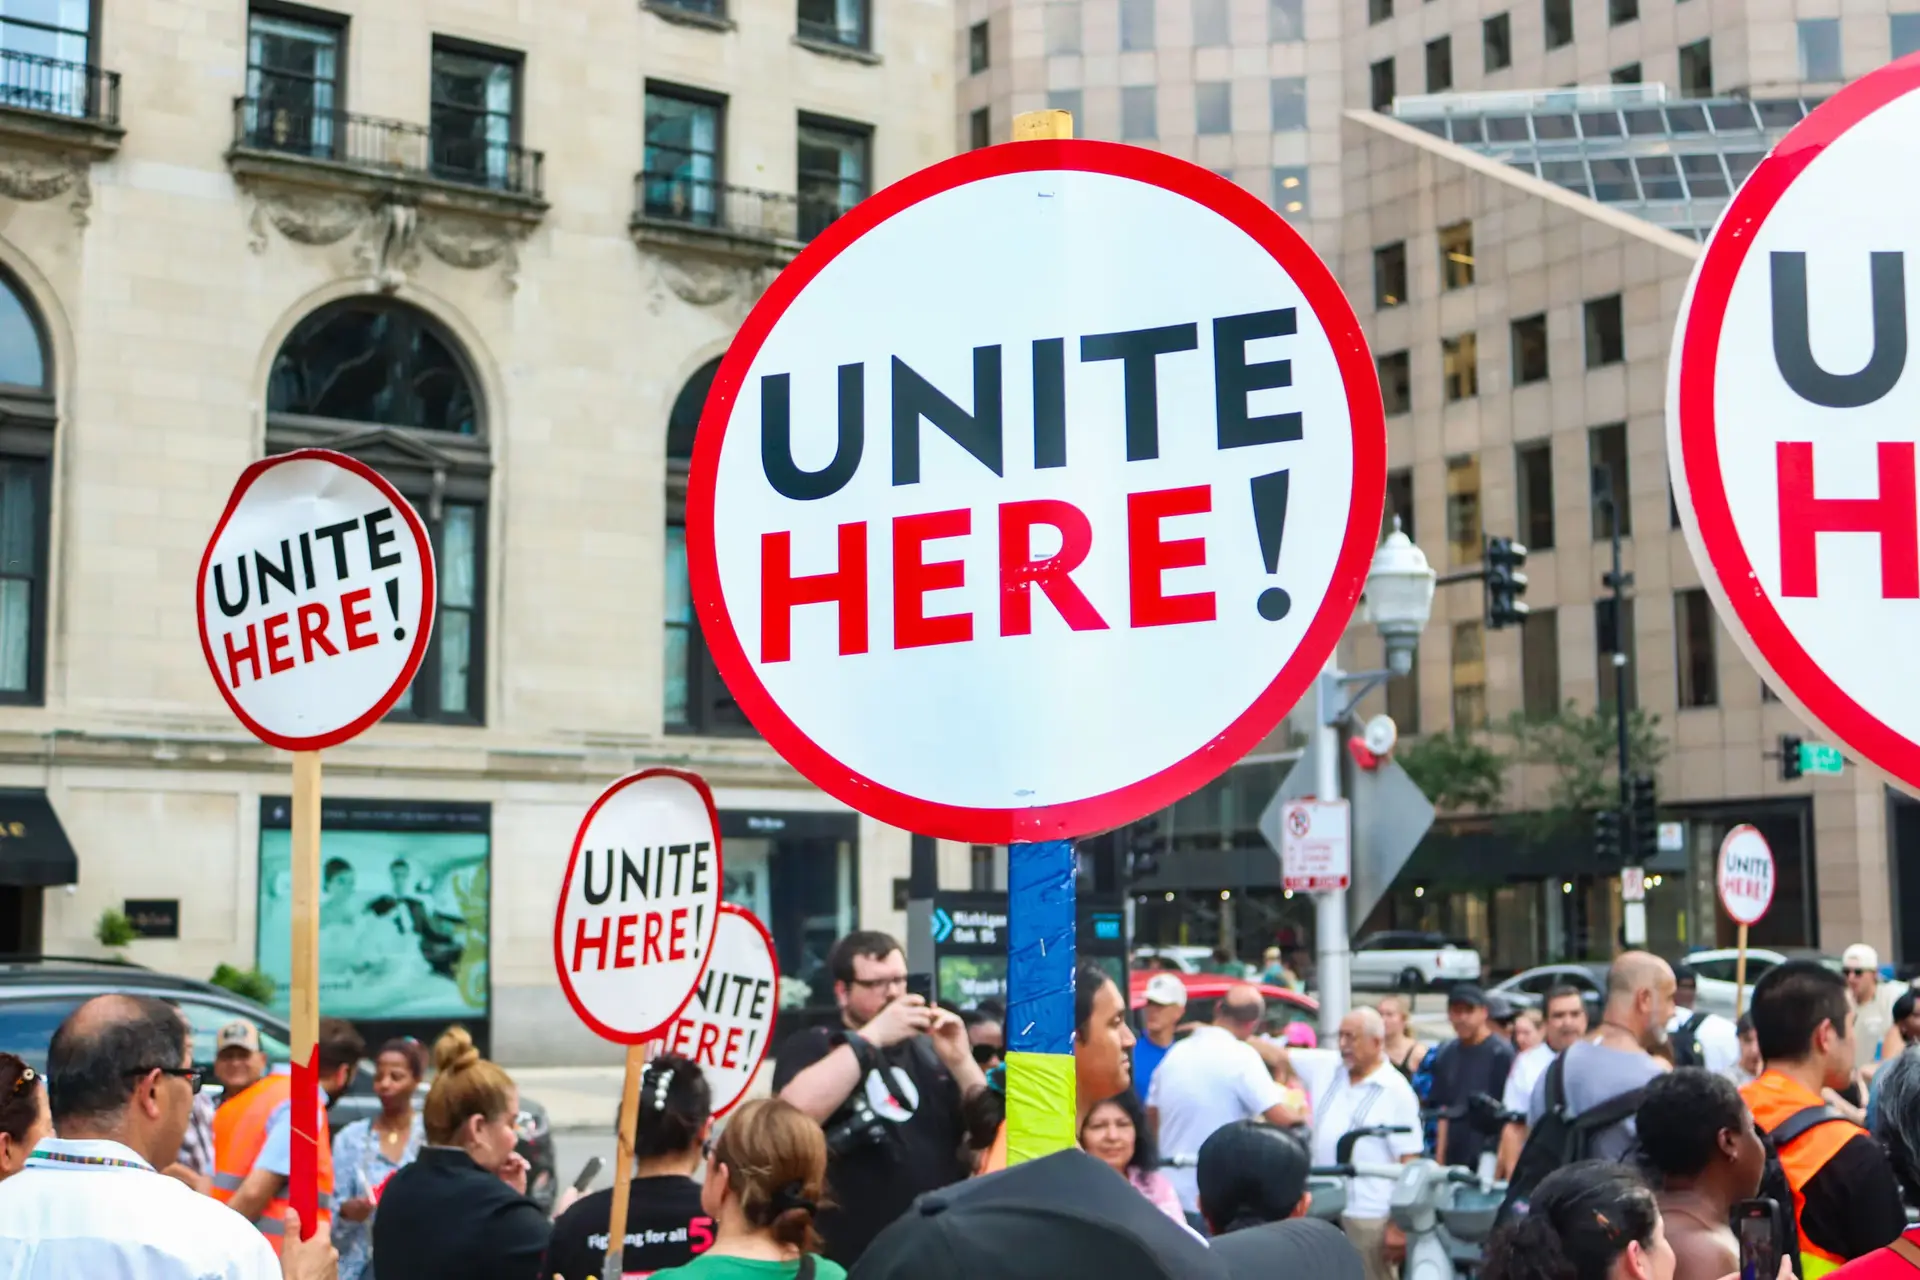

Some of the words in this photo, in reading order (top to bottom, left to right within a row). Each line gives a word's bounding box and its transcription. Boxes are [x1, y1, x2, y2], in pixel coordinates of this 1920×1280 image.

[760, 307, 1303, 501] UNITE
[213, 506, 402, 617] UNITE
[760, 468, 1292, 664] HERE!
[223, 577, 406, 689] HERE!
[583, 841, 710, 905] UNITE
[572, 904, 704, 972] HERE!
[645, 1229, 667, 1243] for
[668, 1227, 687, 1242] all
[688, 1216, 714, 1254] 5
